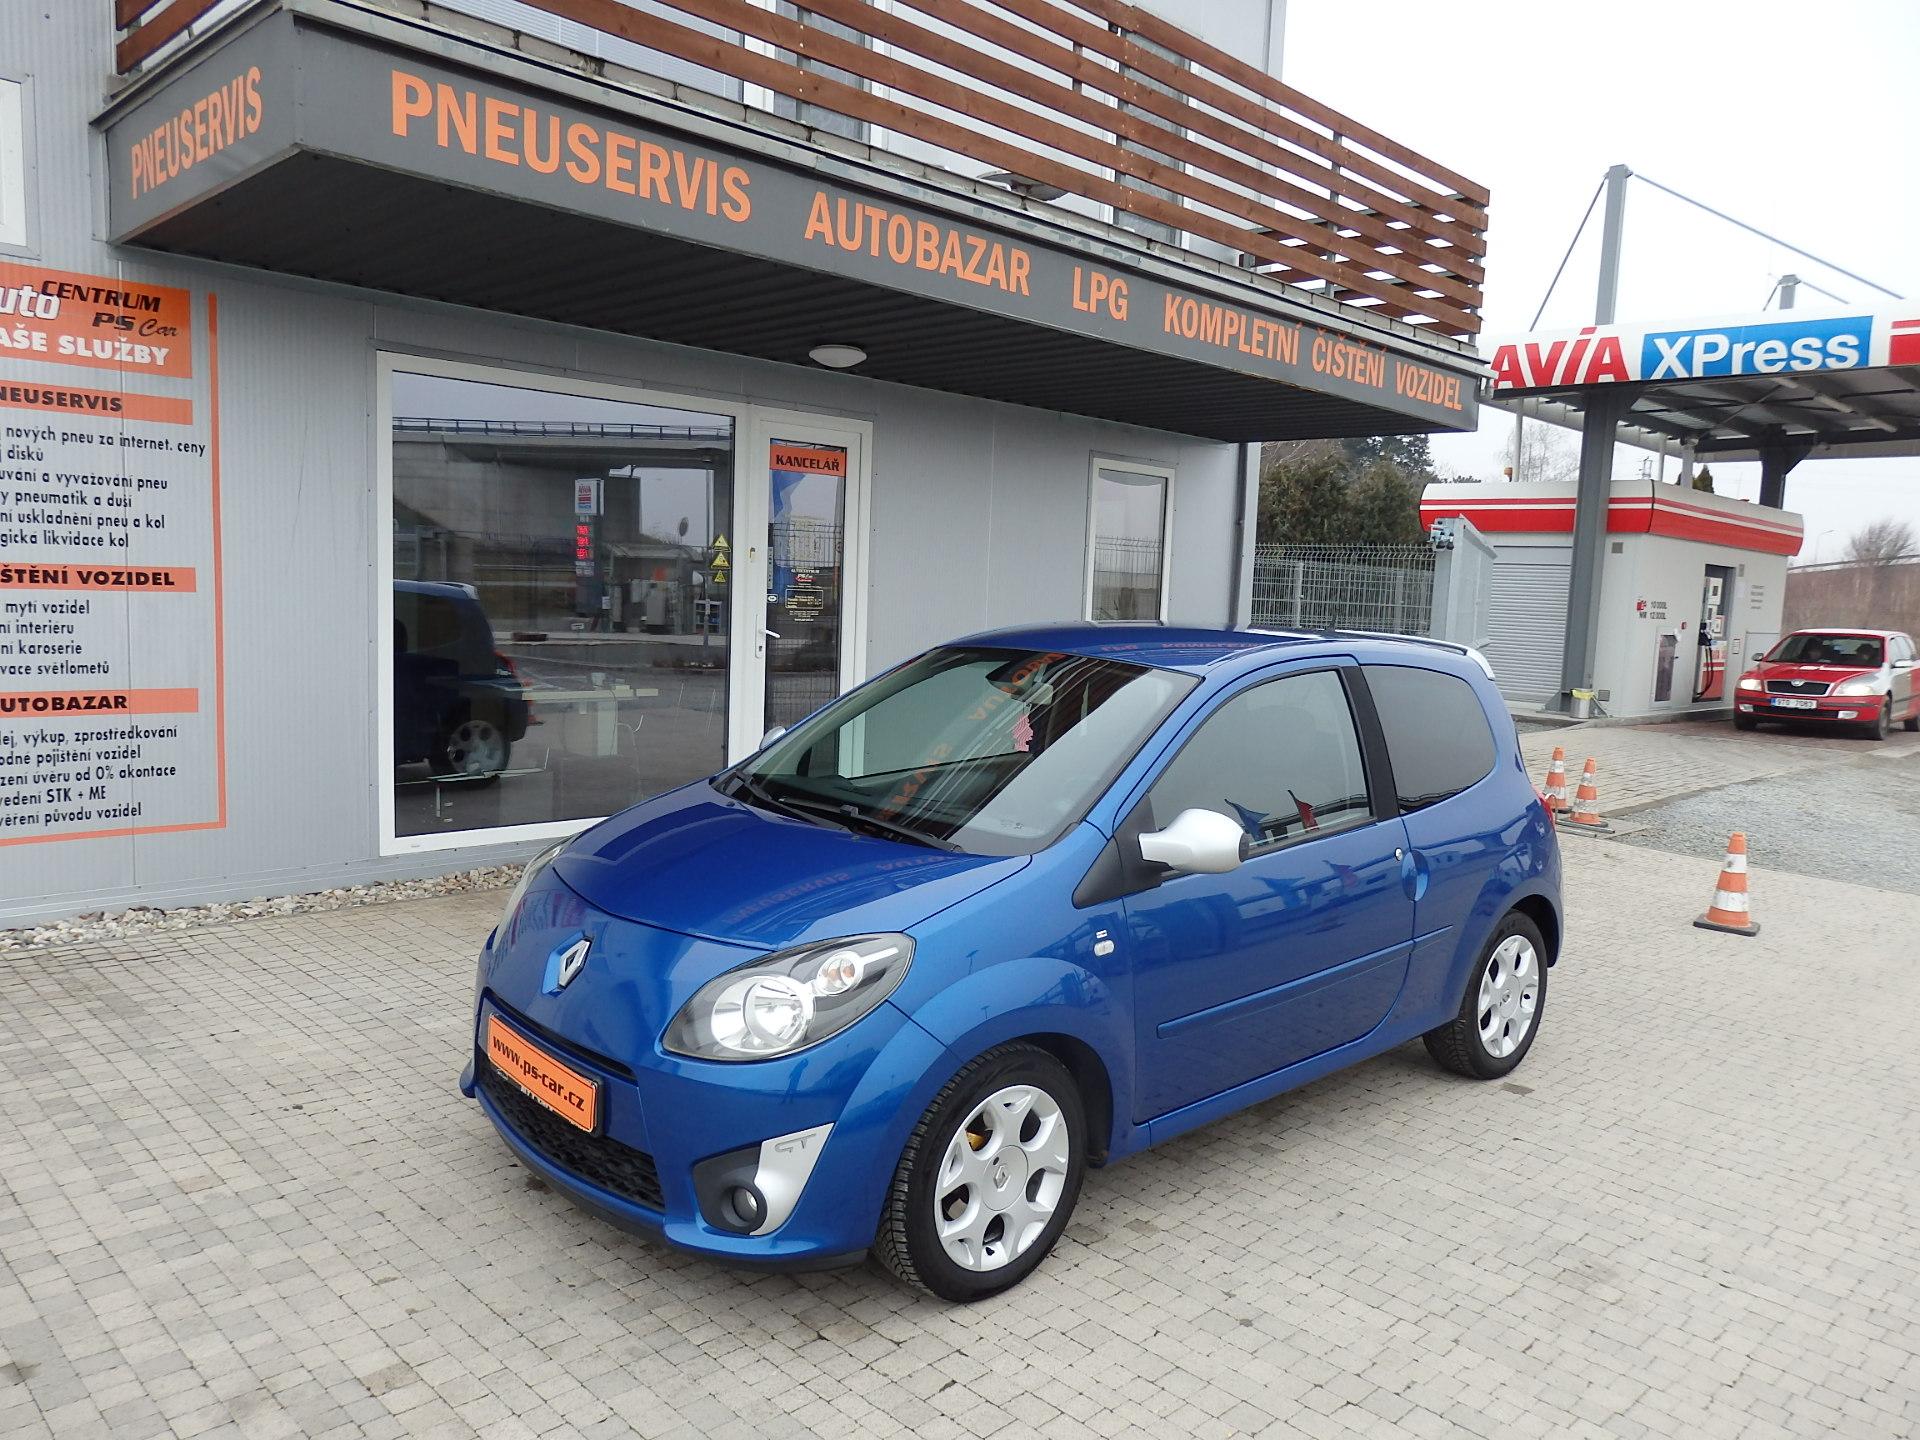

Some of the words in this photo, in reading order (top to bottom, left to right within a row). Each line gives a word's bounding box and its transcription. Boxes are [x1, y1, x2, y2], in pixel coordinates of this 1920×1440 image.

[131, 65, 262, 199] PNEUSERVIS
[391, 70, 751, 222] PNEUSERVIS
[804, 190, 1031, 297] AUTOBAZAR
[1072, 266, 1128, 321] LPG
[1163, 293, 1302, 366] KOMPLETNÍ
[1311, 325, 1387, 389] ČIŠTĚNÍ
[1395, 361, 1463, 411] VOZIDEL
[41, 280, 161, 312] CENTRUM
[92, 311, 136, 331] PS
[138, 318, 178, 337] Car
[58, 336, 169, 366] SLUŽBY
[1651, 333, 1860, 379] XPress
[6, 426, 57, 443] nových
[61, 432, 94, 446] pneu
[98, 435, 114, 446] za
[119, 431, 174, 451] internet.
[177, 442, 206, 458] ceny
[775, 454, 840, 471] KANCELÁŘ
[42, 472, 50, 482] a
[137, 478, 168, 491] pneu
[15, 490, 88, 506] pneumatik
[94, 496, 101, 506] a
[97, 516, 128, 529] pneu
[133, 518, 140, 528] a
[145, 513, 165, 528] kol
[43, 529, 104, 546] likvidace
[109, 532, 128, 547] kol
[76, 570, 175, 586] VOZIDEL
[42, 599, 90, 614] vozidel
[18, 639, 83, 654] karoserie
[0, 694, 128, 713] UTOBAZAR
[23, 728, 69, 748] výkup,
[96, 744, 141, 761] vozidel
[75, 766, 91, 781] od
[96, 764, 115, 781] 0%
[118, 763, 177, 779] akontace
[46, 787, 72, 803] STK
[89, 784, 107, 800] ME
[96, 801, 142, 819] vozidel
[493, 1034, 585, 1112] www.ps-car.cz
